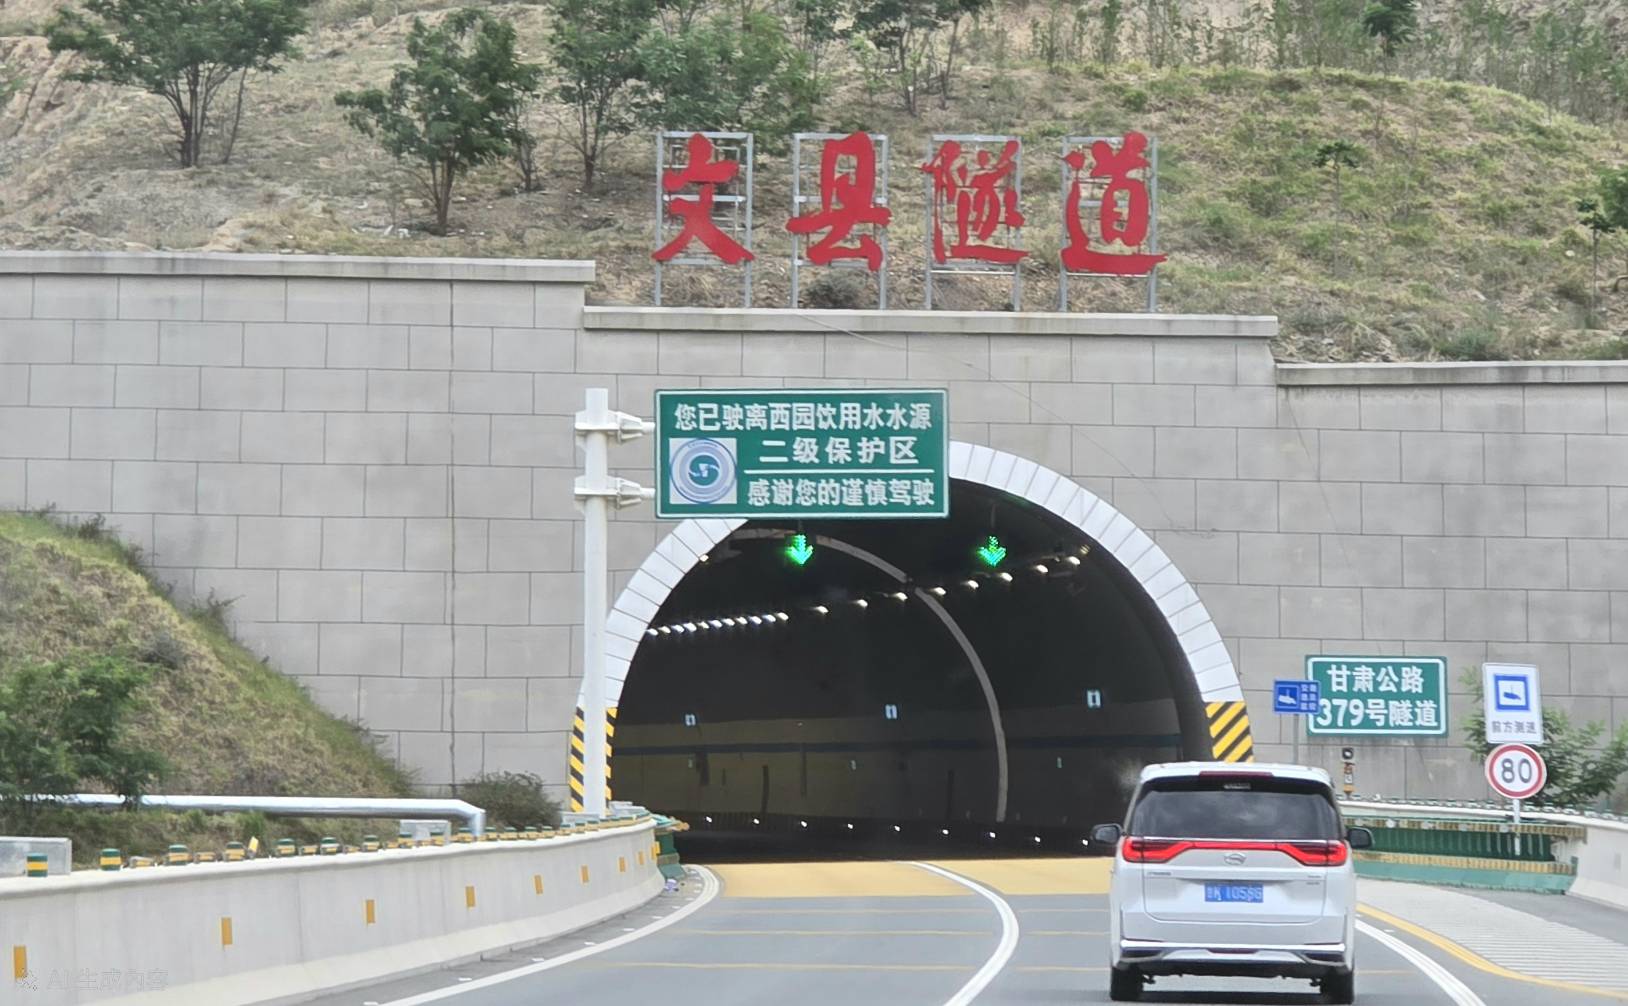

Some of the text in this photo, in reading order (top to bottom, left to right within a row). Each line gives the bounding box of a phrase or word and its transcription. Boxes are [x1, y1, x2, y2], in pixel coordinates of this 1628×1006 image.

[652, 131, 1168, 274] 文县隧道
[674, 402, 932, 431] 您已驶离西园饮用水水源
[759, 436, 919, 464] 二级保护区
[748, 478, 935, 506] 感谢您的谨慎驾驶
[1326, 664, 1425, 694] 甘肃公路
[1316, 698, 1438, 727] 379号隧道
[1501, 758, 1532, 784] 80
